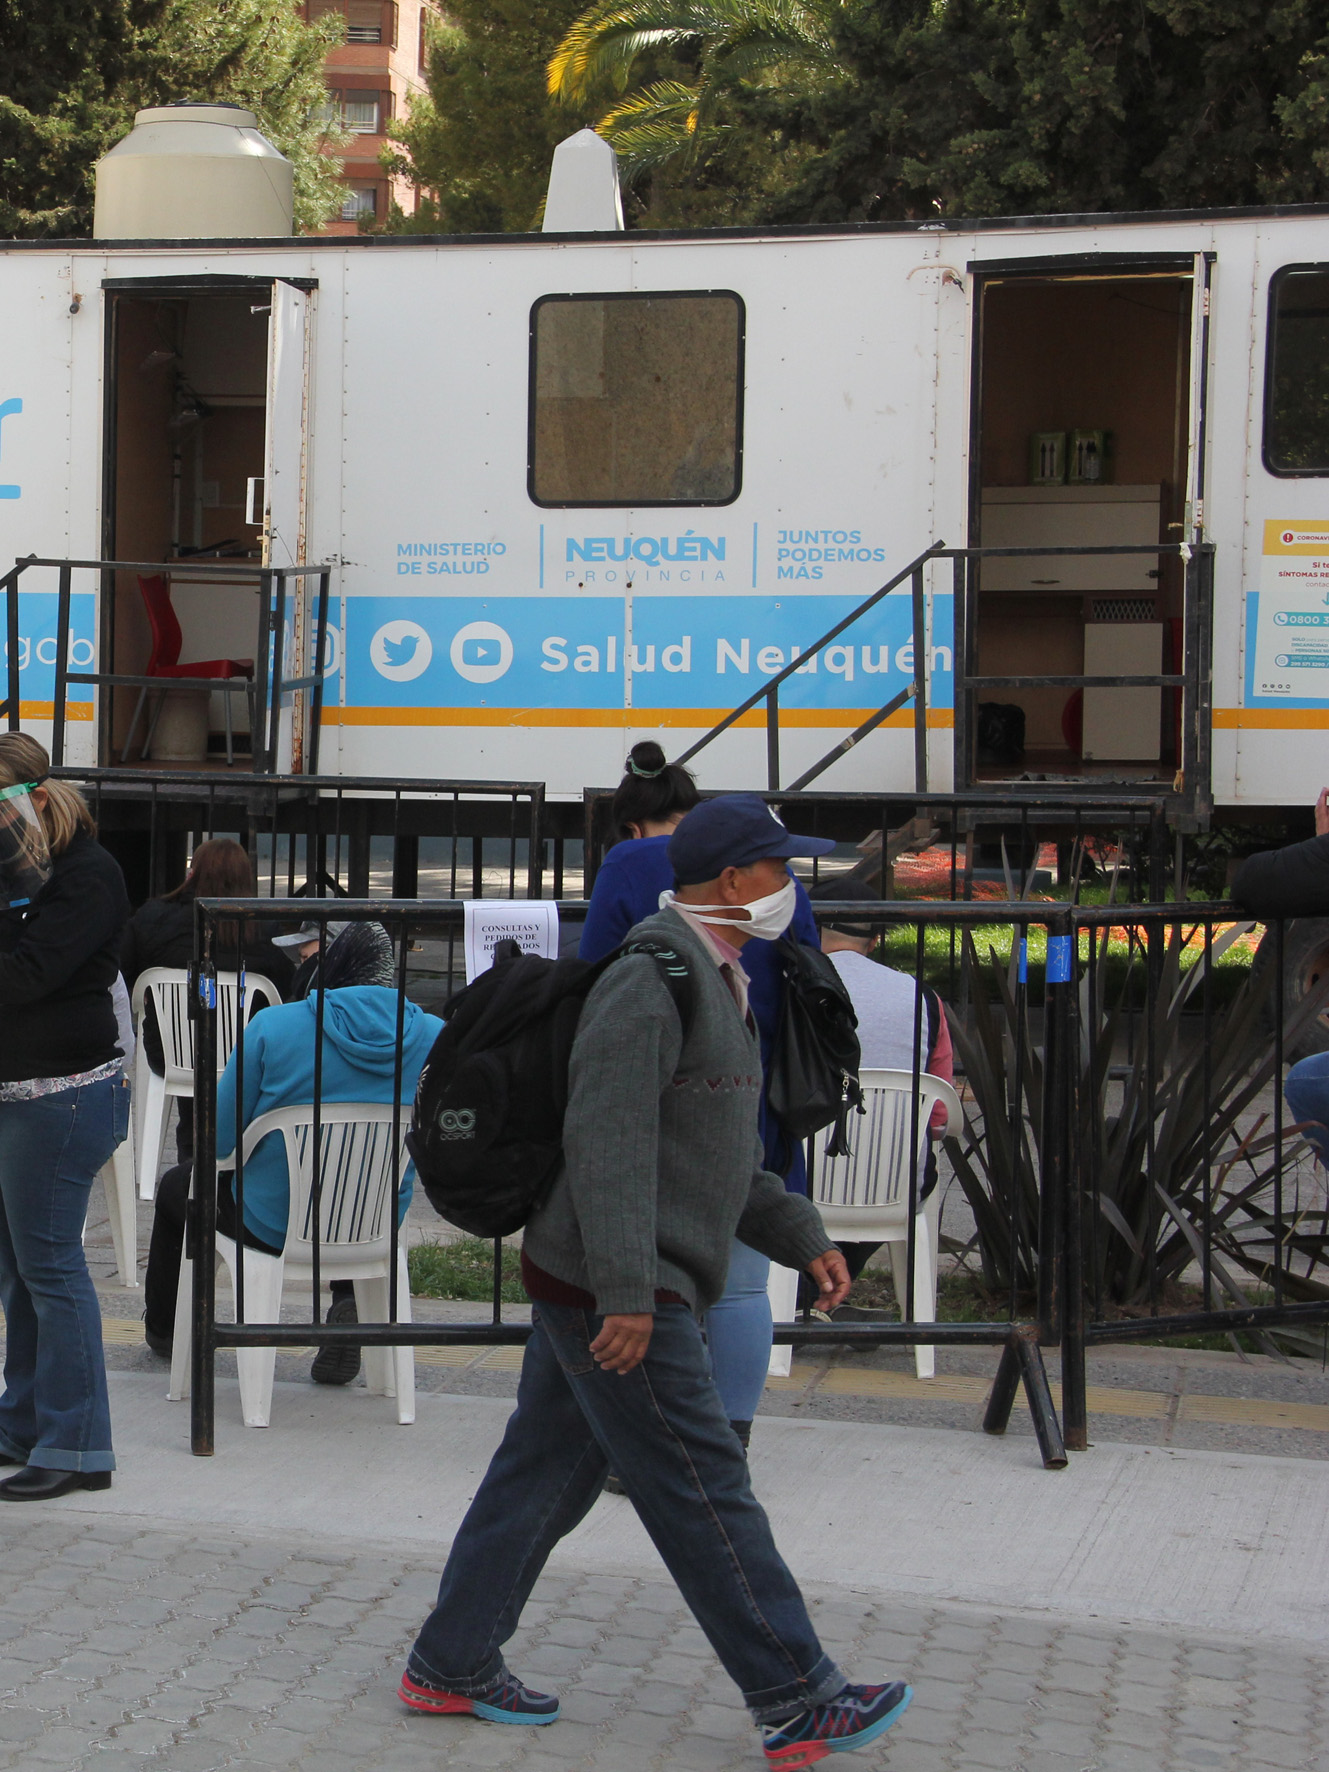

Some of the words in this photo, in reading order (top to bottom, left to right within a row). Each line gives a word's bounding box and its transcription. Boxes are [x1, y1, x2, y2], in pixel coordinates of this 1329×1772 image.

[776, 530, 862, 545] JUNTOS
[396, 542, 507, 557] MINISTERIO
[565, 529, 726, 568] NEUQUÉN
[776, 547, 886, 563] PODEMOS
[396, 562, 422, 575] DE
[426, 561, 491, 575] SALUD
[776, 562, 823, 580] MÁS
[565, 570, 726, 583] PROVINCIA
[1289, 616, 1320, 624] 0800
[540, 635, 692, 674] Salud
[715, 634, 953, 682] Neuquén
